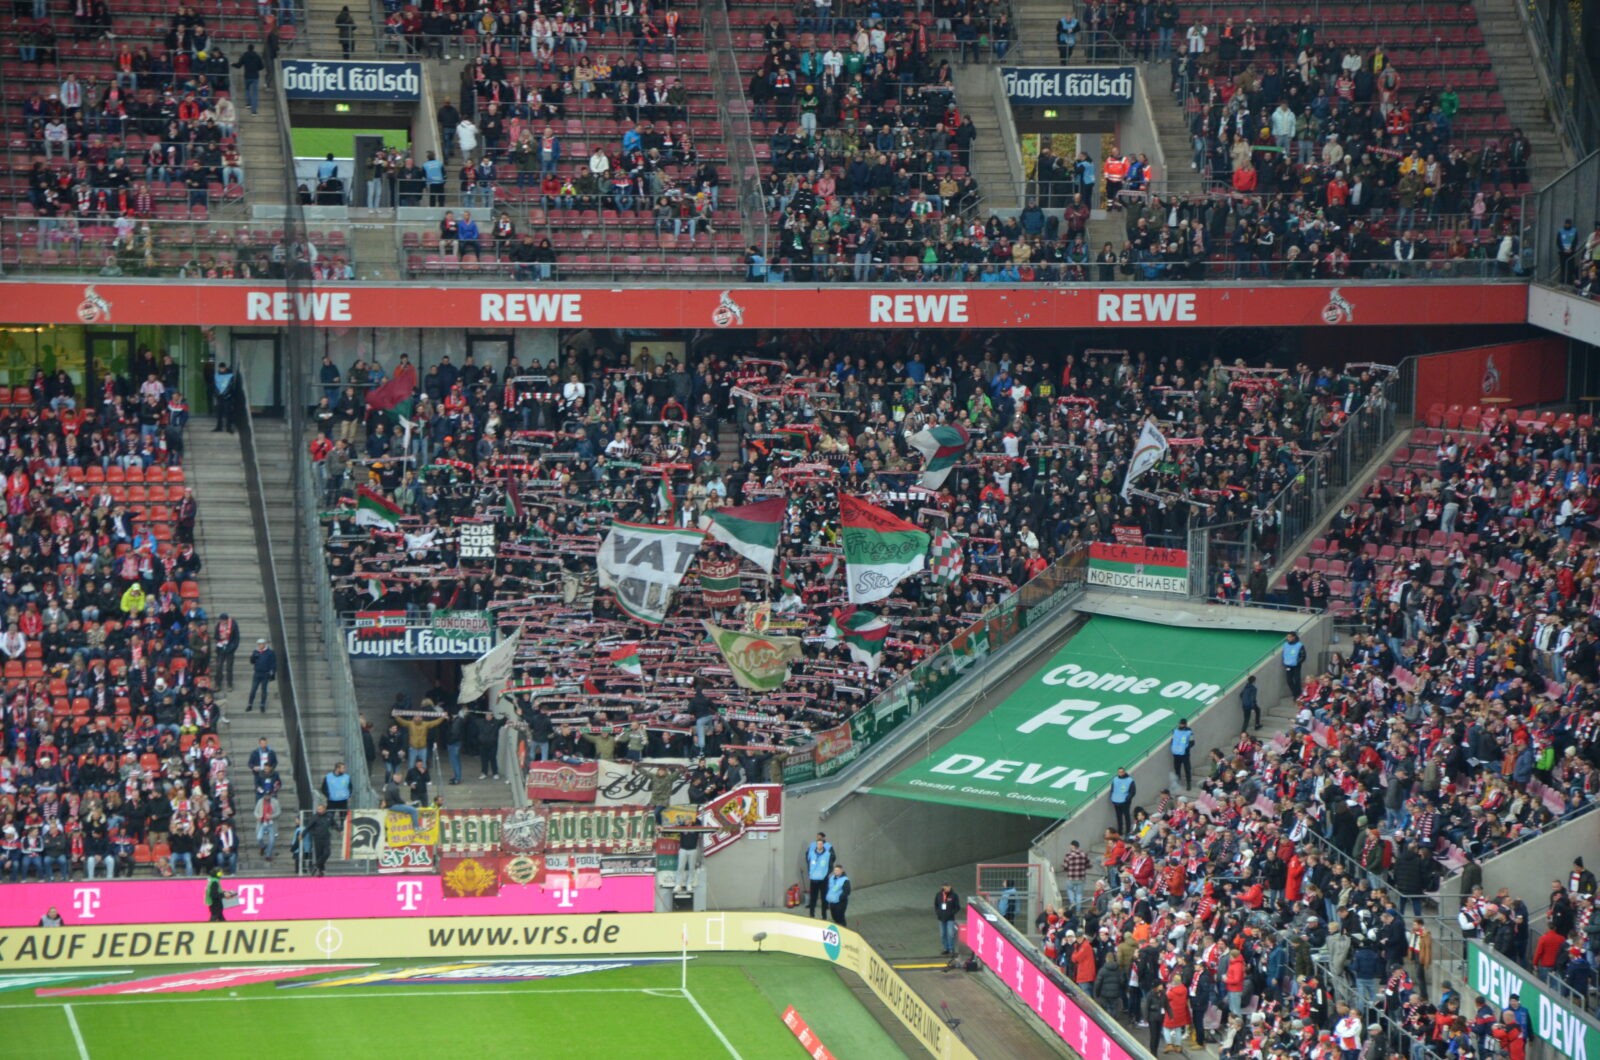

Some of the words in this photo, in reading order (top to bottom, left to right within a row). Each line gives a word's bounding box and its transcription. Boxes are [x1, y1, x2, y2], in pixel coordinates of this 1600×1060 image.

[283, 62, 346, 92] Gaffel
[348, 67, 419, 95] Kölsch
[1065, 72, 1133, 99] Kölsch
[246, 292, 352, 321] REWE
[480, 293, 583, 322] REWE
[869, 294, 969, 323] REWE
[1097, 293, 1197, 322] REWE
[460, 524, 495, 535] CON
[460, 535, 495, 546] COR
[460, 546, 496, 557] DIA
[1090, 569, 1187, 592] NORDSCHWABEN
[433, 617, 491, 631] CONCORDIA
[1041, 663, 1161, 694] Come
[1159, 680, 1222, 705] on,
[1016, 698, 1175, 745] FC!
[929, 753, 1112, 793] DEVK
[440, 819, 500, 844] LEGIO
[548, 814, 655, 842] AUGUSTA
[14, 933, 87, 962] AUF
[92, 930, 195, 959] JEDER
[204, 927, 297, 956] LINIE.
[428, 917, 621, 948] www.vrs.de
[821, 929, 838, 945] VRS
[868, 956, 889, 998] STARK
[888, 977, 902, 1011] AUF
[901, 991, 922, 1034] JEDER
[1538, 992, 1587, 1060] DEVK
